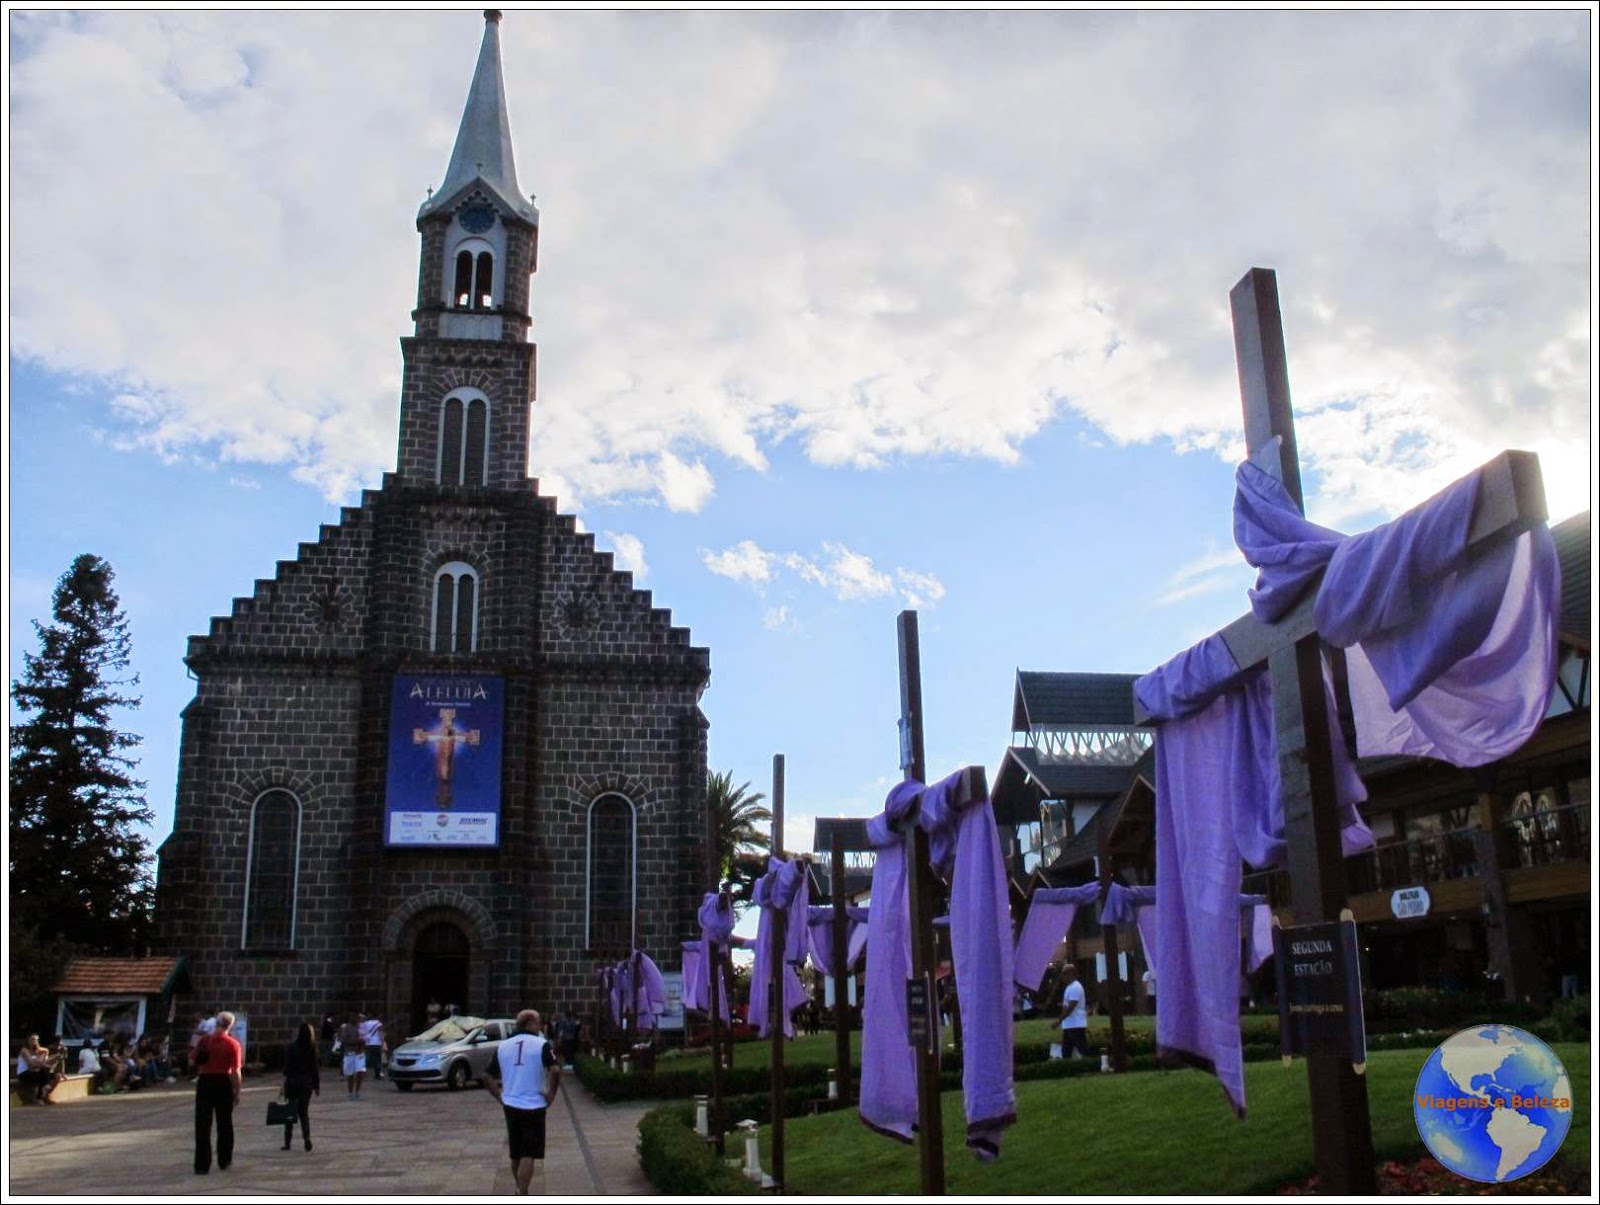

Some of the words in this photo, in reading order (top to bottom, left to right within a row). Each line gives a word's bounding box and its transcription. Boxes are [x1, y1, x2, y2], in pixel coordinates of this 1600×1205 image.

[410, 682, 487, 700] ALELUIA
[1291, 940, 1333, 955] SEGUNDA
[1294, 960, 1333, 976] ESTAÇÃO
[514, 1040, 524, 1066] 1
